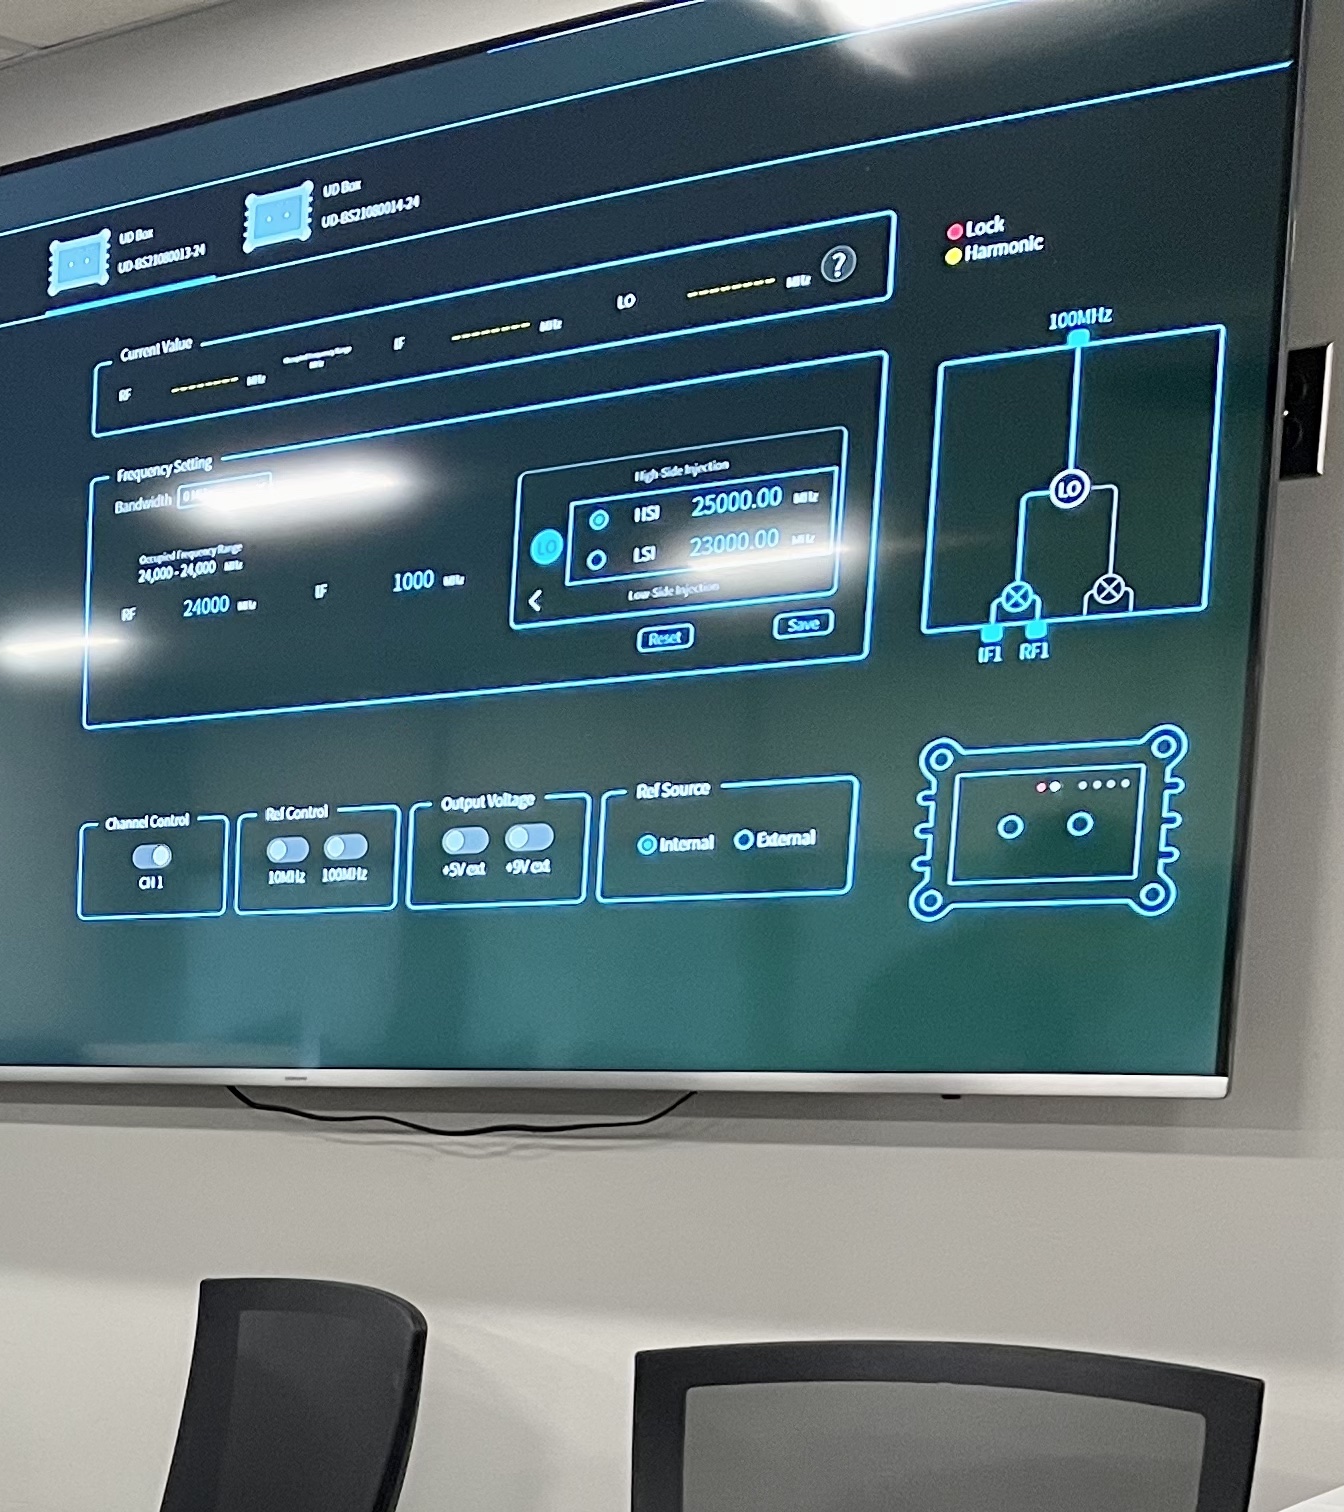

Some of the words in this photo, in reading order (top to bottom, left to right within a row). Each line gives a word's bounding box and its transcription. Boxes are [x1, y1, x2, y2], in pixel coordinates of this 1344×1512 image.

[965, 215, 1005, 239] Lock
[965, 234, 1045, 263] Harmonic
[616, 292, 637, 310] LO
[1048, 306, 1114, 331] 100MHz
[120, 339, 161, 362] Current
[161, 336, 194, 355] Value
[116, 463, 173, 484] Frequency
[173, 456, 213, 474] Setting
[1058, 480, 1081, 499] LO
[114, 493, 173, 514] Bandwidth
[633, 504, 661, 523] HSI
[691, 485, 784, 518] 25000.00
[632, 545, 658, 564] LSI
[689, 527, 780, 557] 23000.00
[392, 569, 436, 593] 1000
[183, 594, 231, 617] 24000
[787, 617, 821, 634] Save
[648, 630, 683, 647] Reset
[1019, 642, 1050, 661] RF1
[636, 781, 660, 800] Ref
[660, 781, 711, 799] Source
[285, 804, 330, 821] Control
[441, 795, 489, 813] Output
[490, 791, 537, 811] Voltage
[105, 815, 149, 832] Channel
[149, 812, 190, 830] Control
[659, 833, 715, 853] Internal
[756, 828, 817, 849] External
